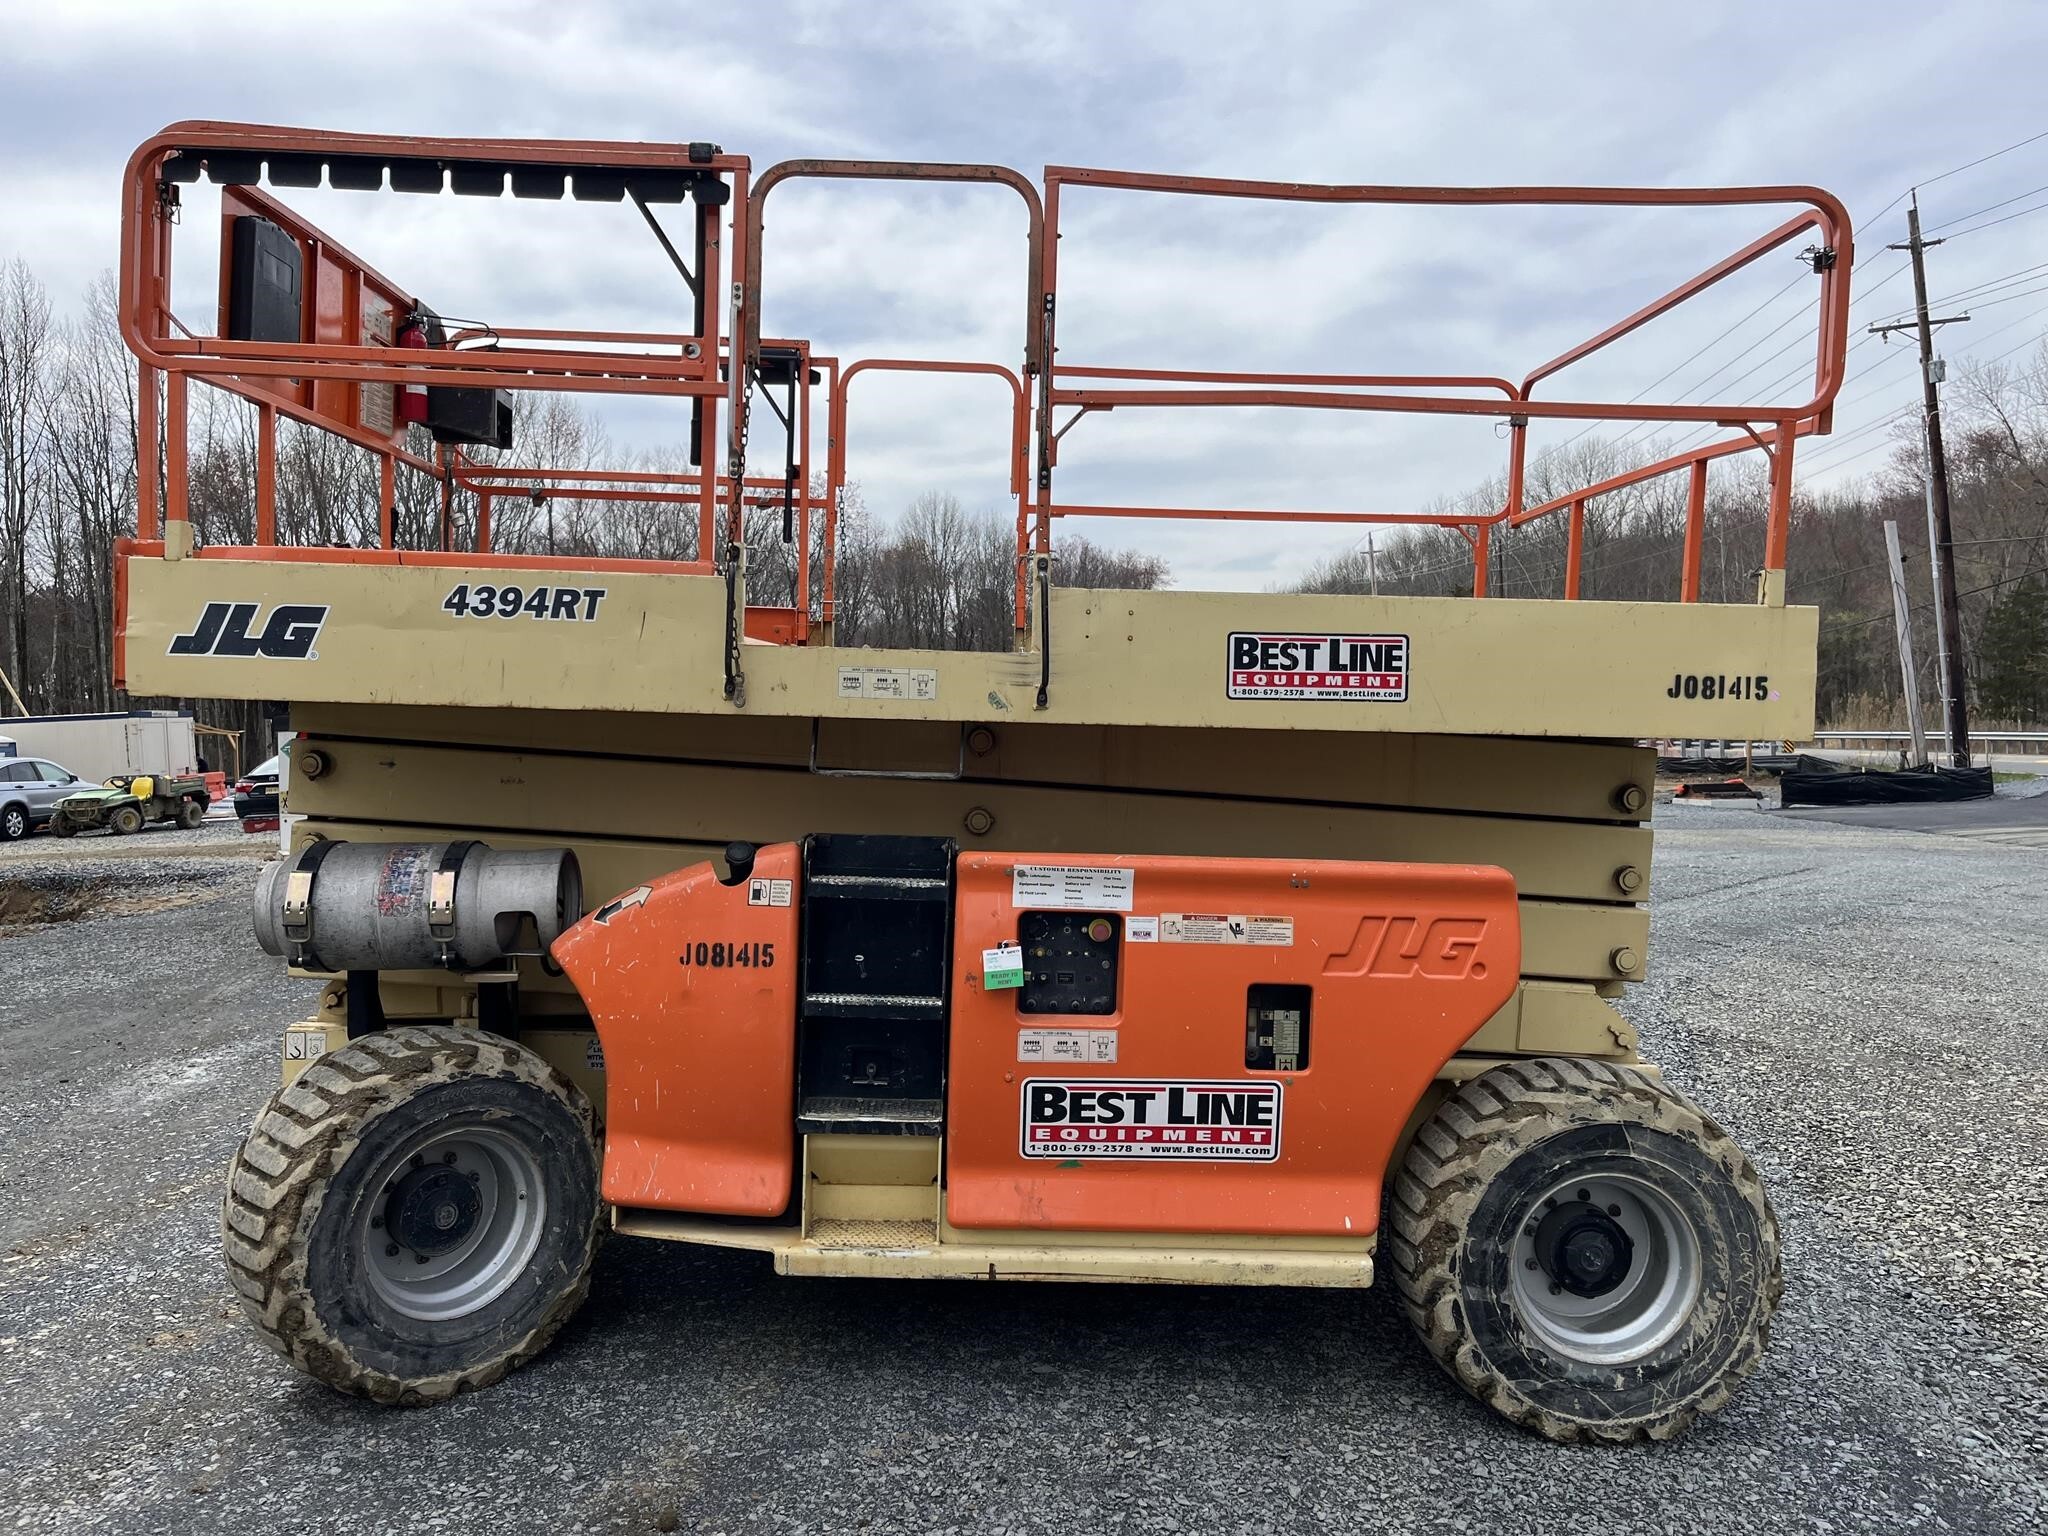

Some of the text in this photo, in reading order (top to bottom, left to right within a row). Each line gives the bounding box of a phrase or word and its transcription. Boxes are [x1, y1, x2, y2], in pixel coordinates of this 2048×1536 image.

[443, 585, 606, 621] 4394RT
[167, 602, 330, 660] JLG
[1234, 637, 1403, 673] BEST LINE
[1232, 688, 1402, 698] 1-800-679-2378 www.BestLine.com
[1236, 674, 1399, 687] EQUIPMENT
[1667, 674, 1768, 701] J081415
[680, 942, 775, 968] J081415
[1031, 1086, 1273, 1126] BEST LINE
[1035, 1128, 1266, 1142] EQUIPMENT
[1029, 1144, 1271, 1155] 1-800-679-2378 www.BestLine.com
